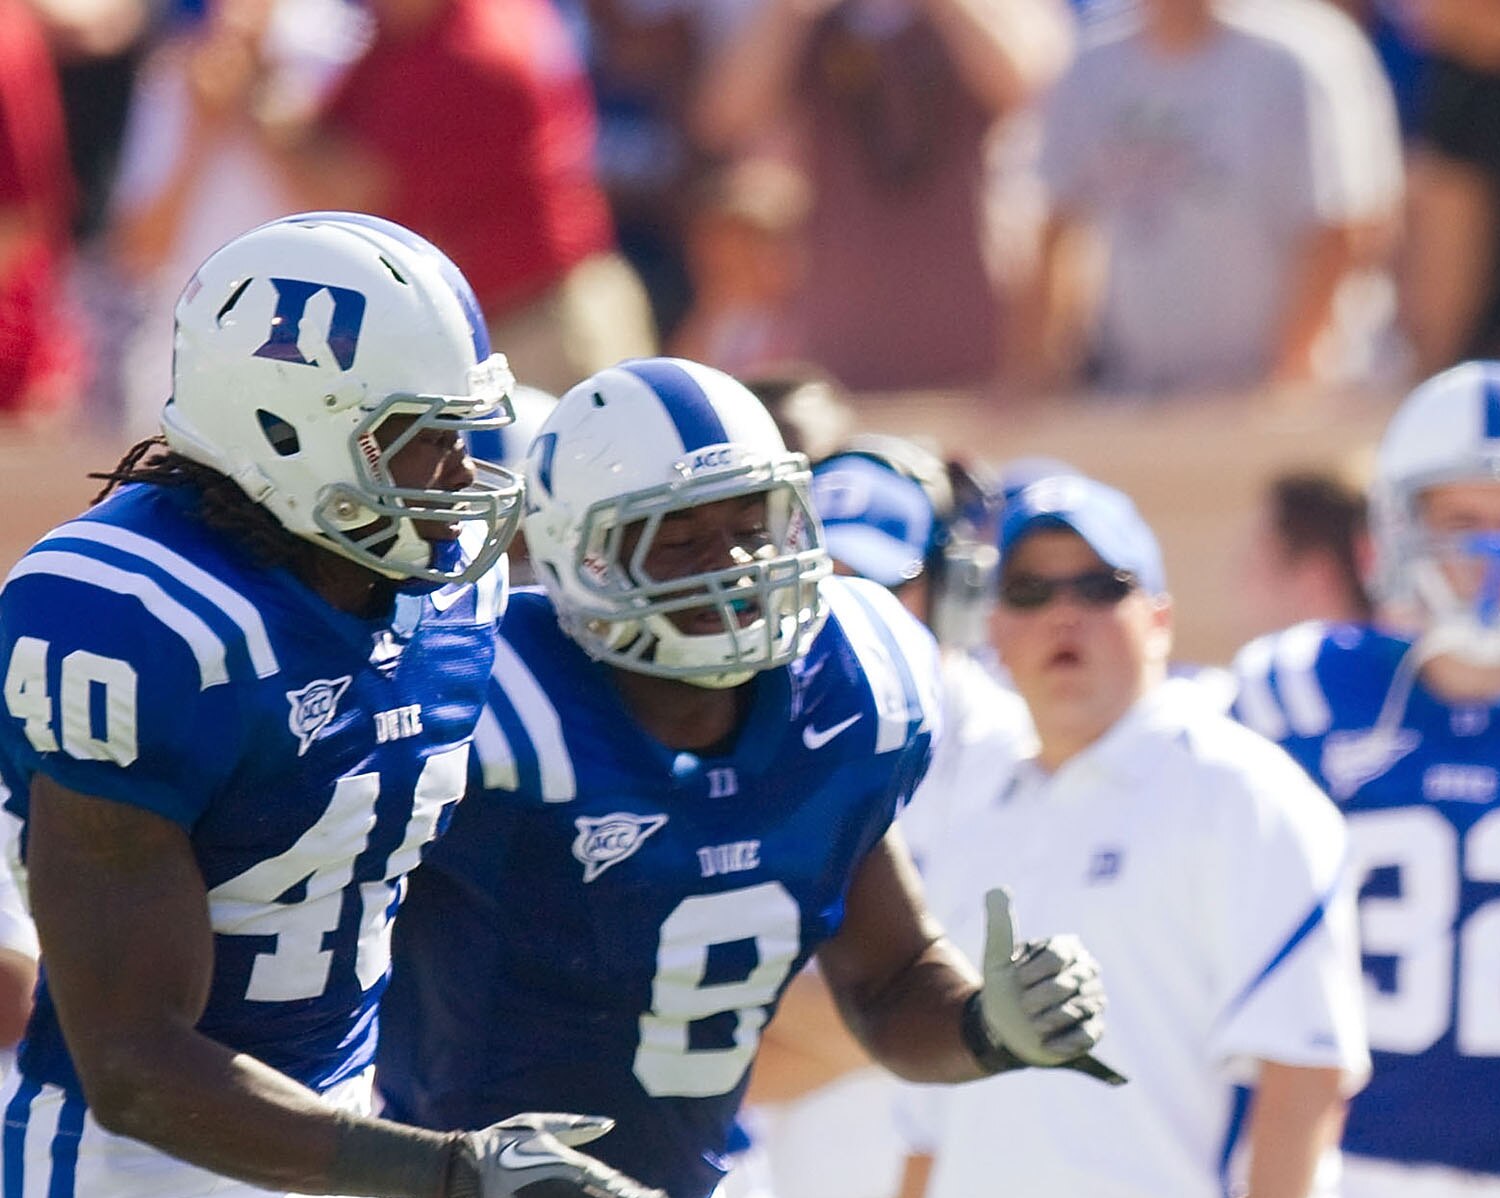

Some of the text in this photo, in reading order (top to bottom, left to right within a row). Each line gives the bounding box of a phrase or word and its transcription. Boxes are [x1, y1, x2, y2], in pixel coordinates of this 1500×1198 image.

[692, 449, 732, 470] ACC
[3, 635, 138, 768] 40
[373, 703, 423, 745] DUKE
[587, 831, 633, 854] ACC
[696, 838, 761, 879] DUKE
[632, 880, 800, 1098] 8
